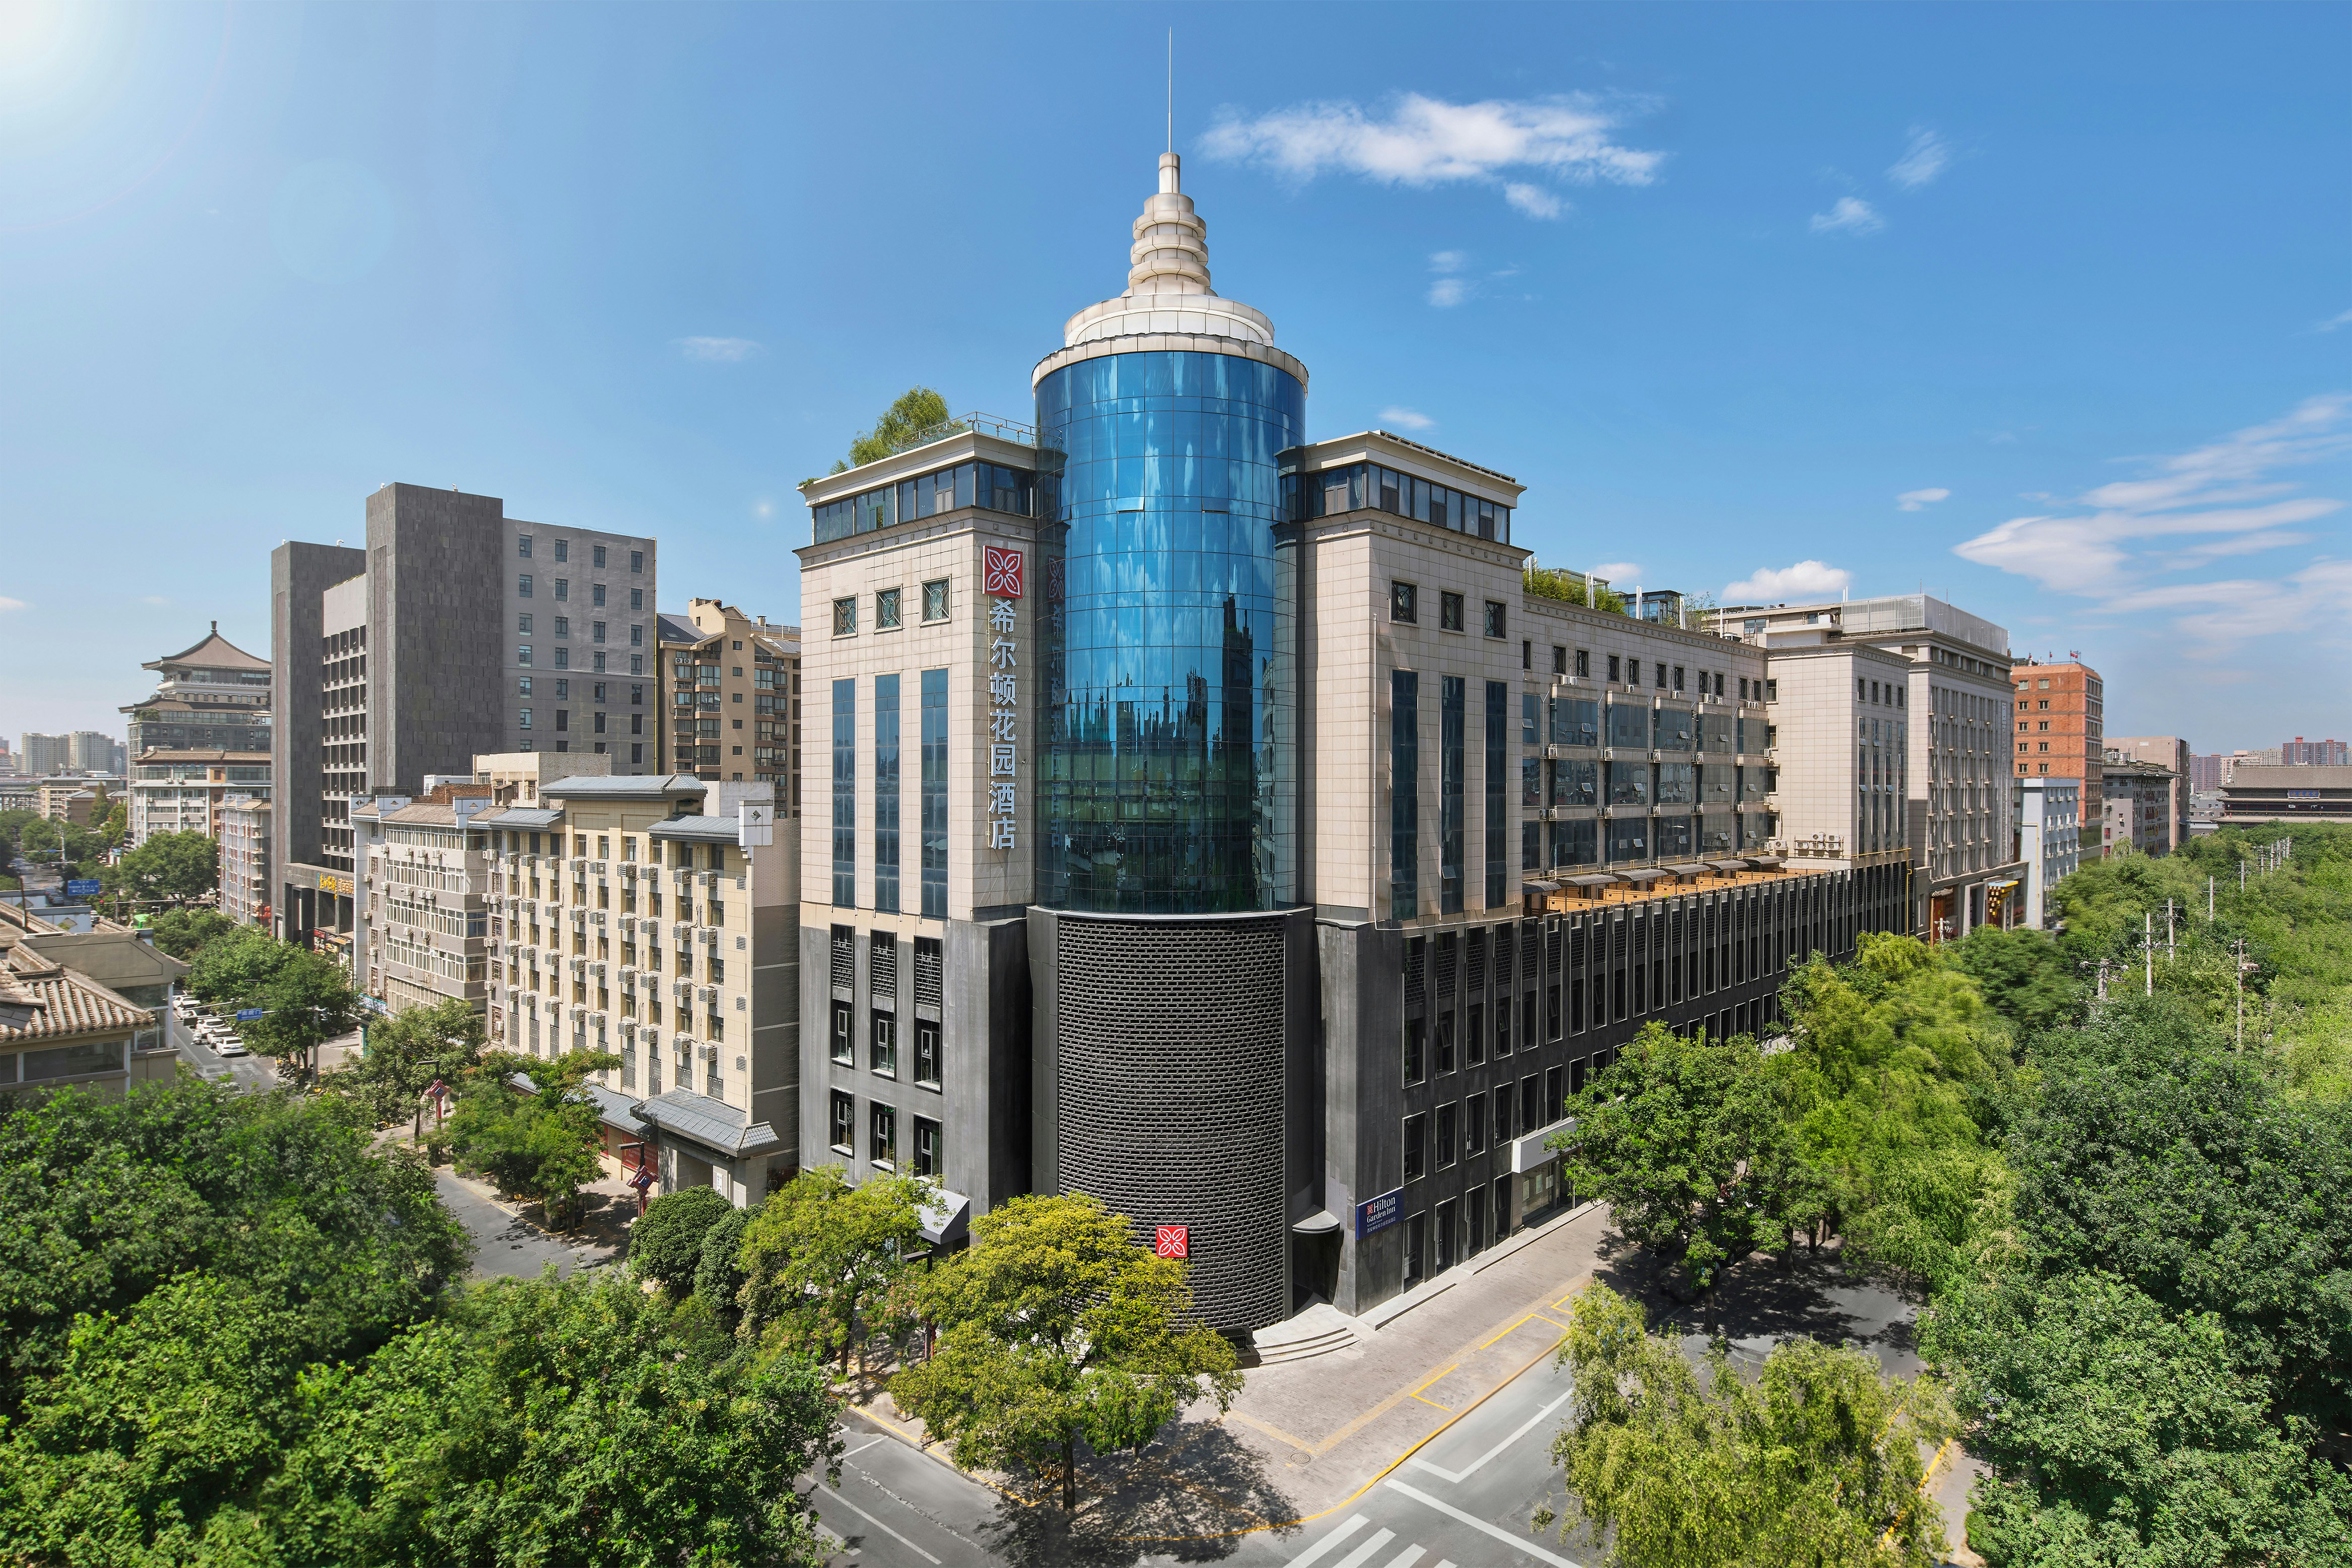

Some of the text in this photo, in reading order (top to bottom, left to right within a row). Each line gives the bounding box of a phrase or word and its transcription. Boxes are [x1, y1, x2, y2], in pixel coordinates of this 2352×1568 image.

[989, 598, 1016, 850] 希尔顿花园酒店
[1373, 1197, 1395, 1213] Hilton
[1367, 1206, 1395, 1223] Garden Inn
